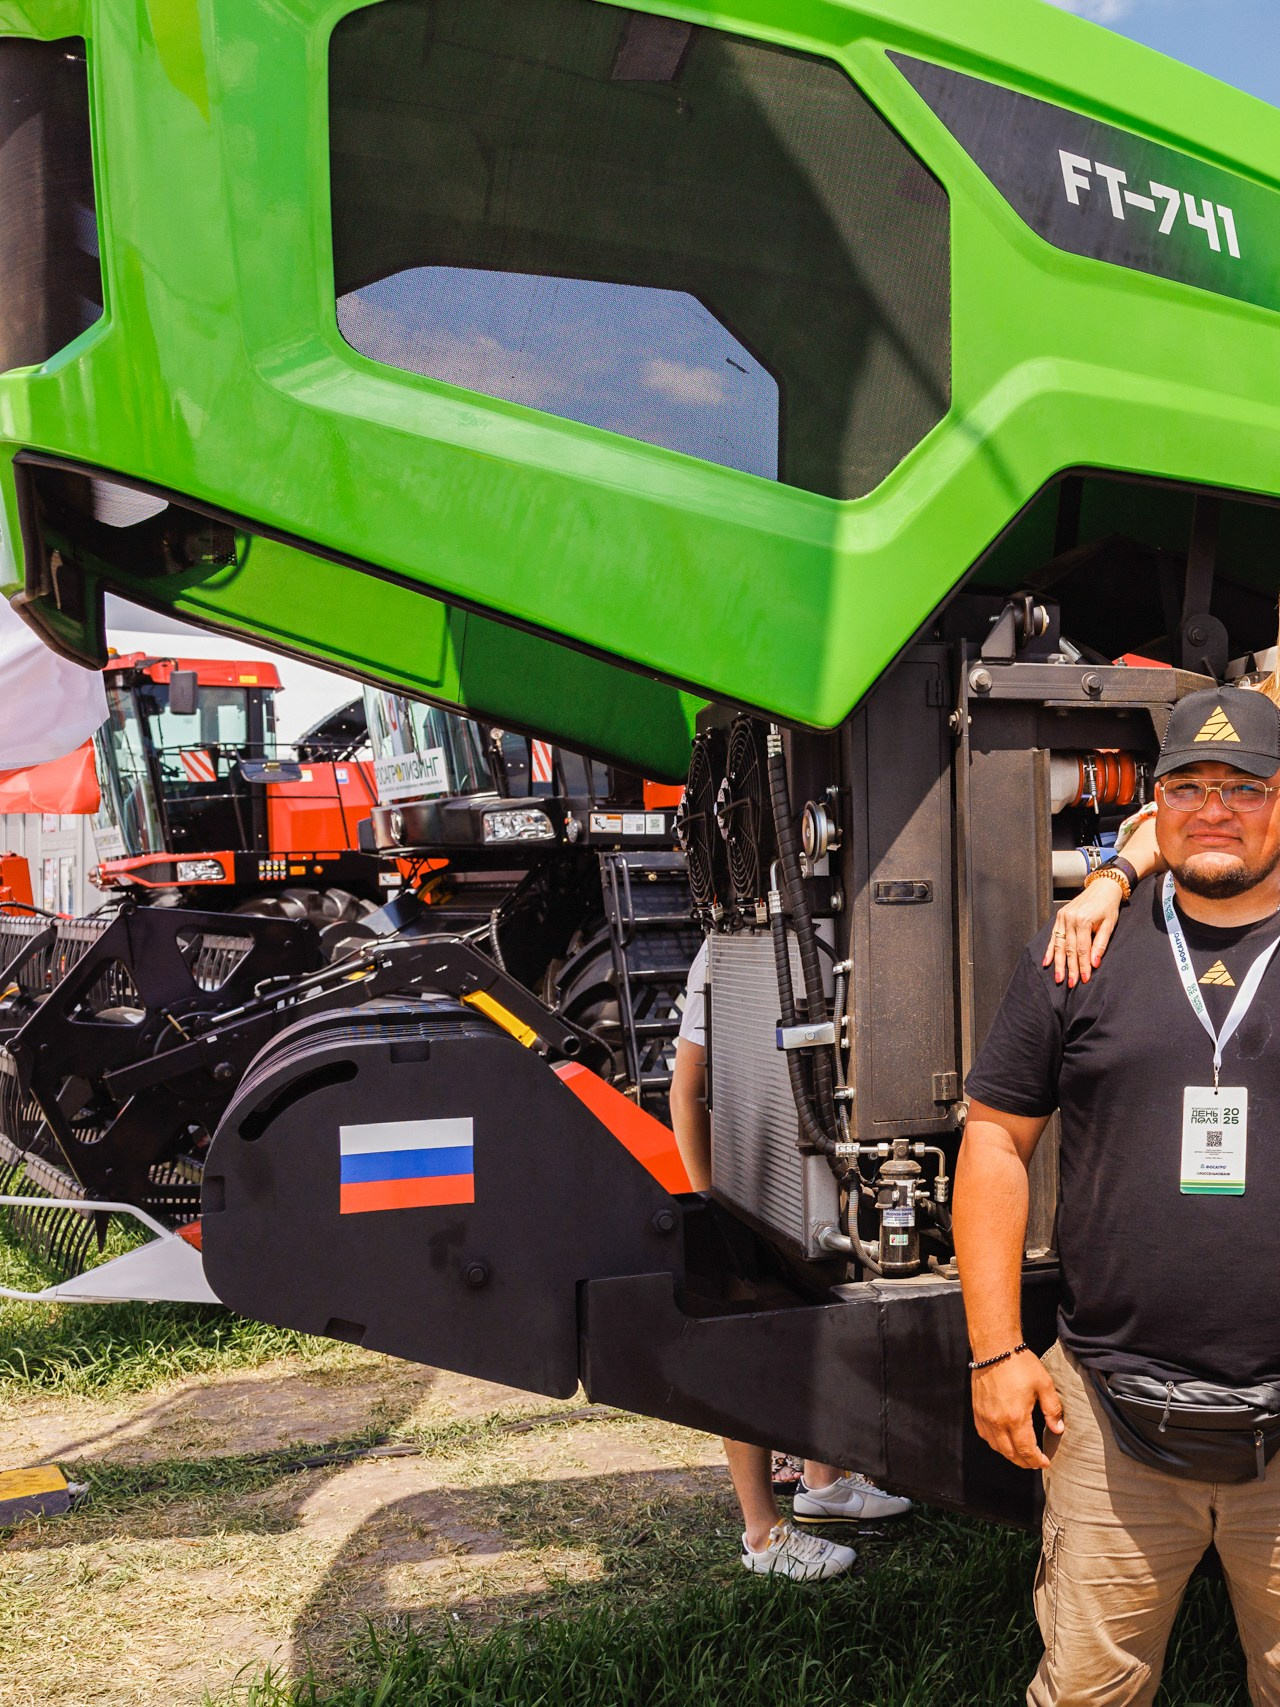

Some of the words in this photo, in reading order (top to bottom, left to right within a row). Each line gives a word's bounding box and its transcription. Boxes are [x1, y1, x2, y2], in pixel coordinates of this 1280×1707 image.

[1058, 149, 1241, 259] FT-741
[1191, 1109, 1219, 1117] ДЕНЬ
[1223, 1107, 1240, 1116] 20
[1223, 1116, 1240, 1125] 25
